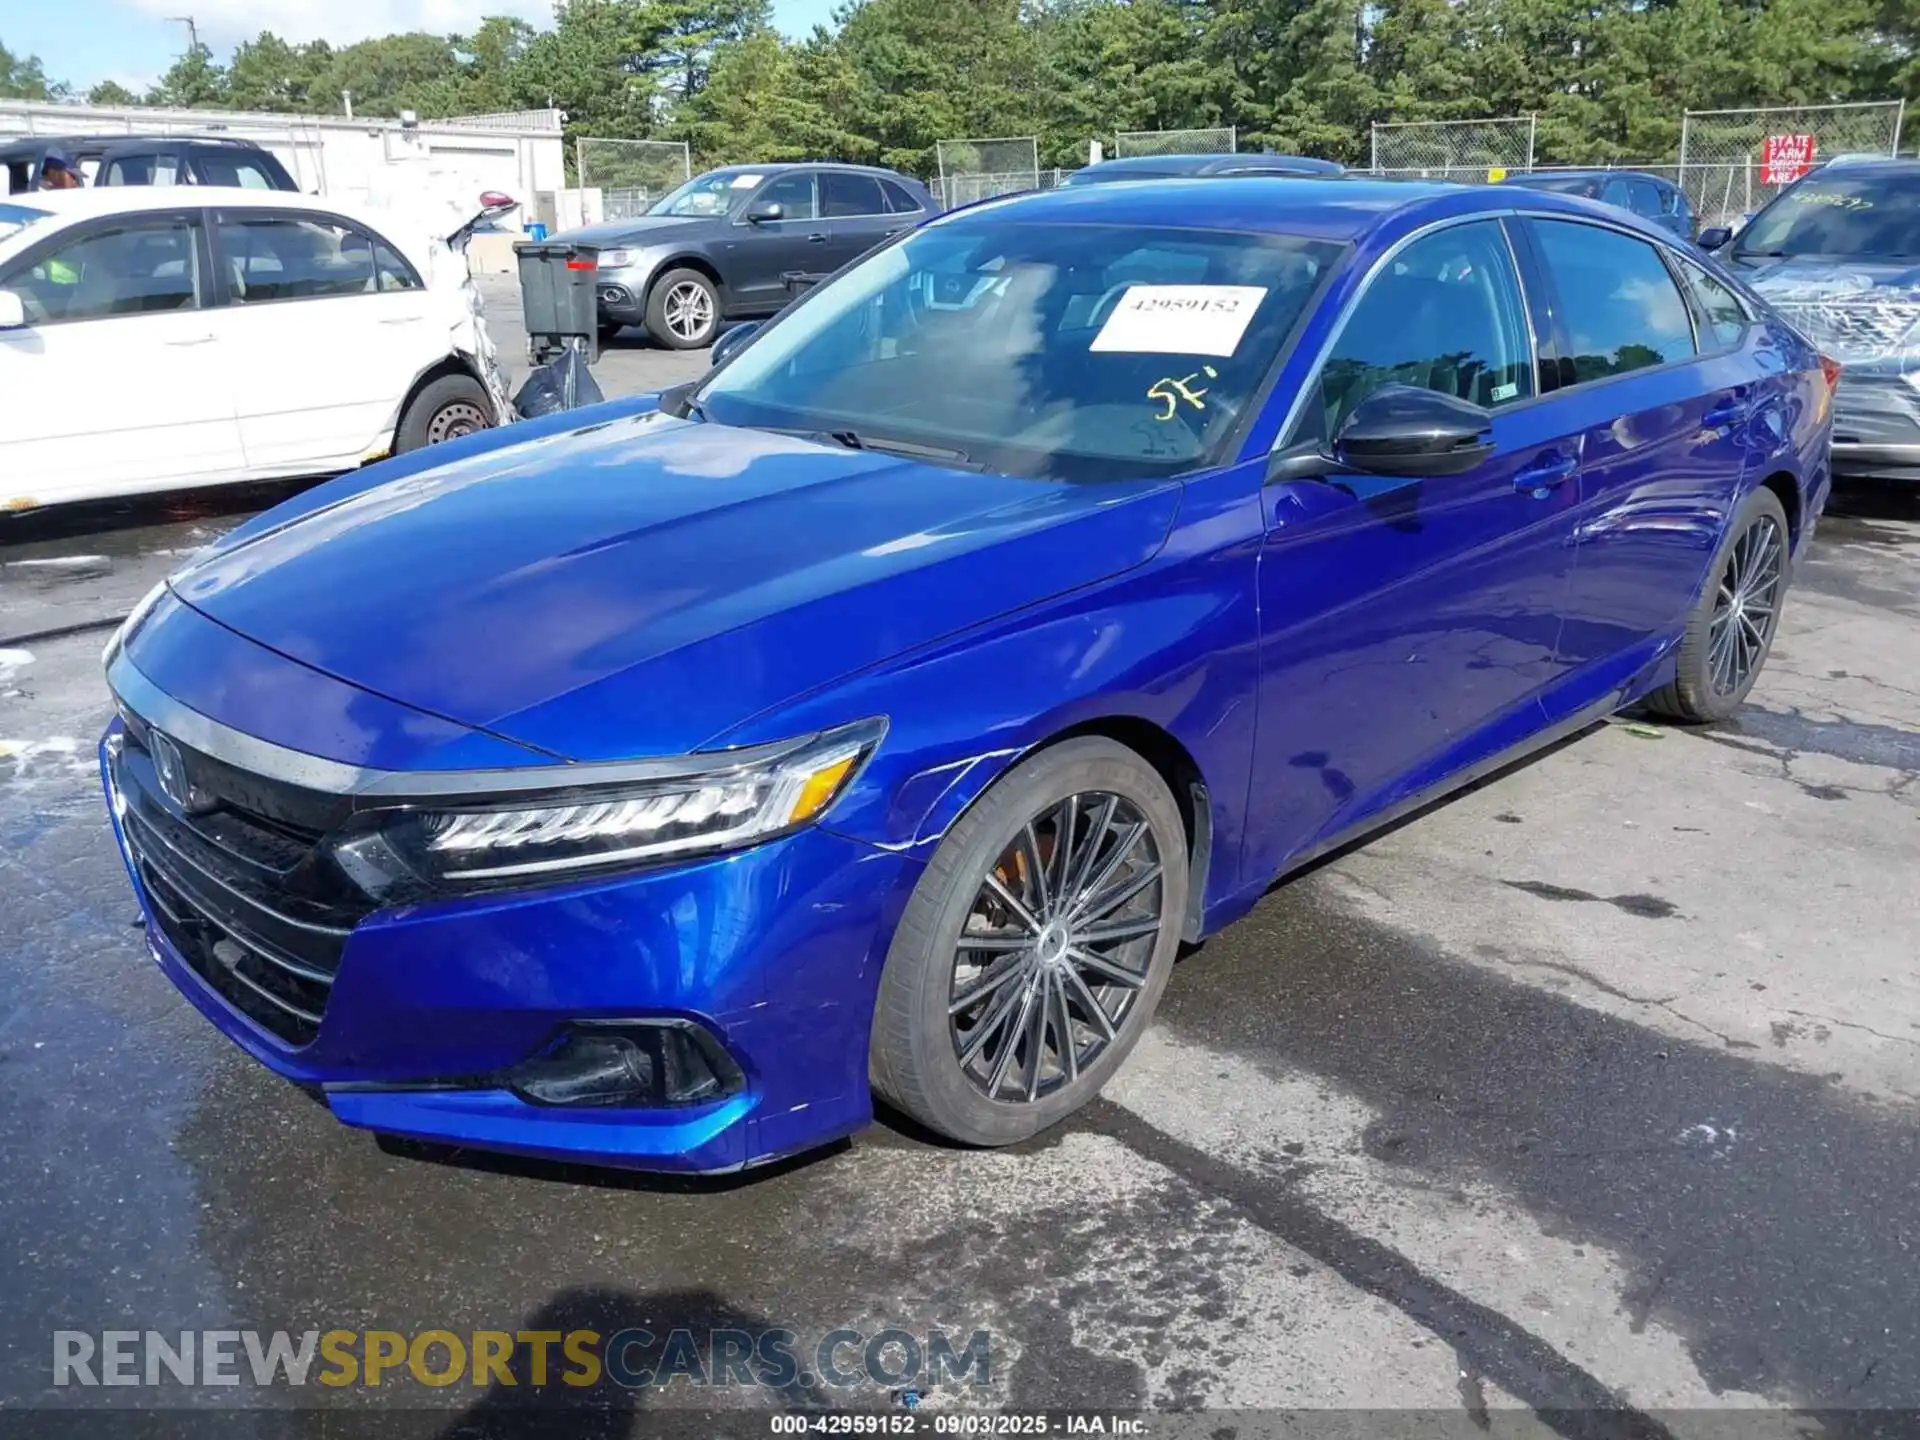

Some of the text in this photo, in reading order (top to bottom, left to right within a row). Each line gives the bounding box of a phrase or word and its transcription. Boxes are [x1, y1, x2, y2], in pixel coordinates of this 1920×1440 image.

[1768, 135, 1811, 149] STATE
[1769, 148, 1807, 161] FARM
[1130, 299, 1239, 313] 42959152
